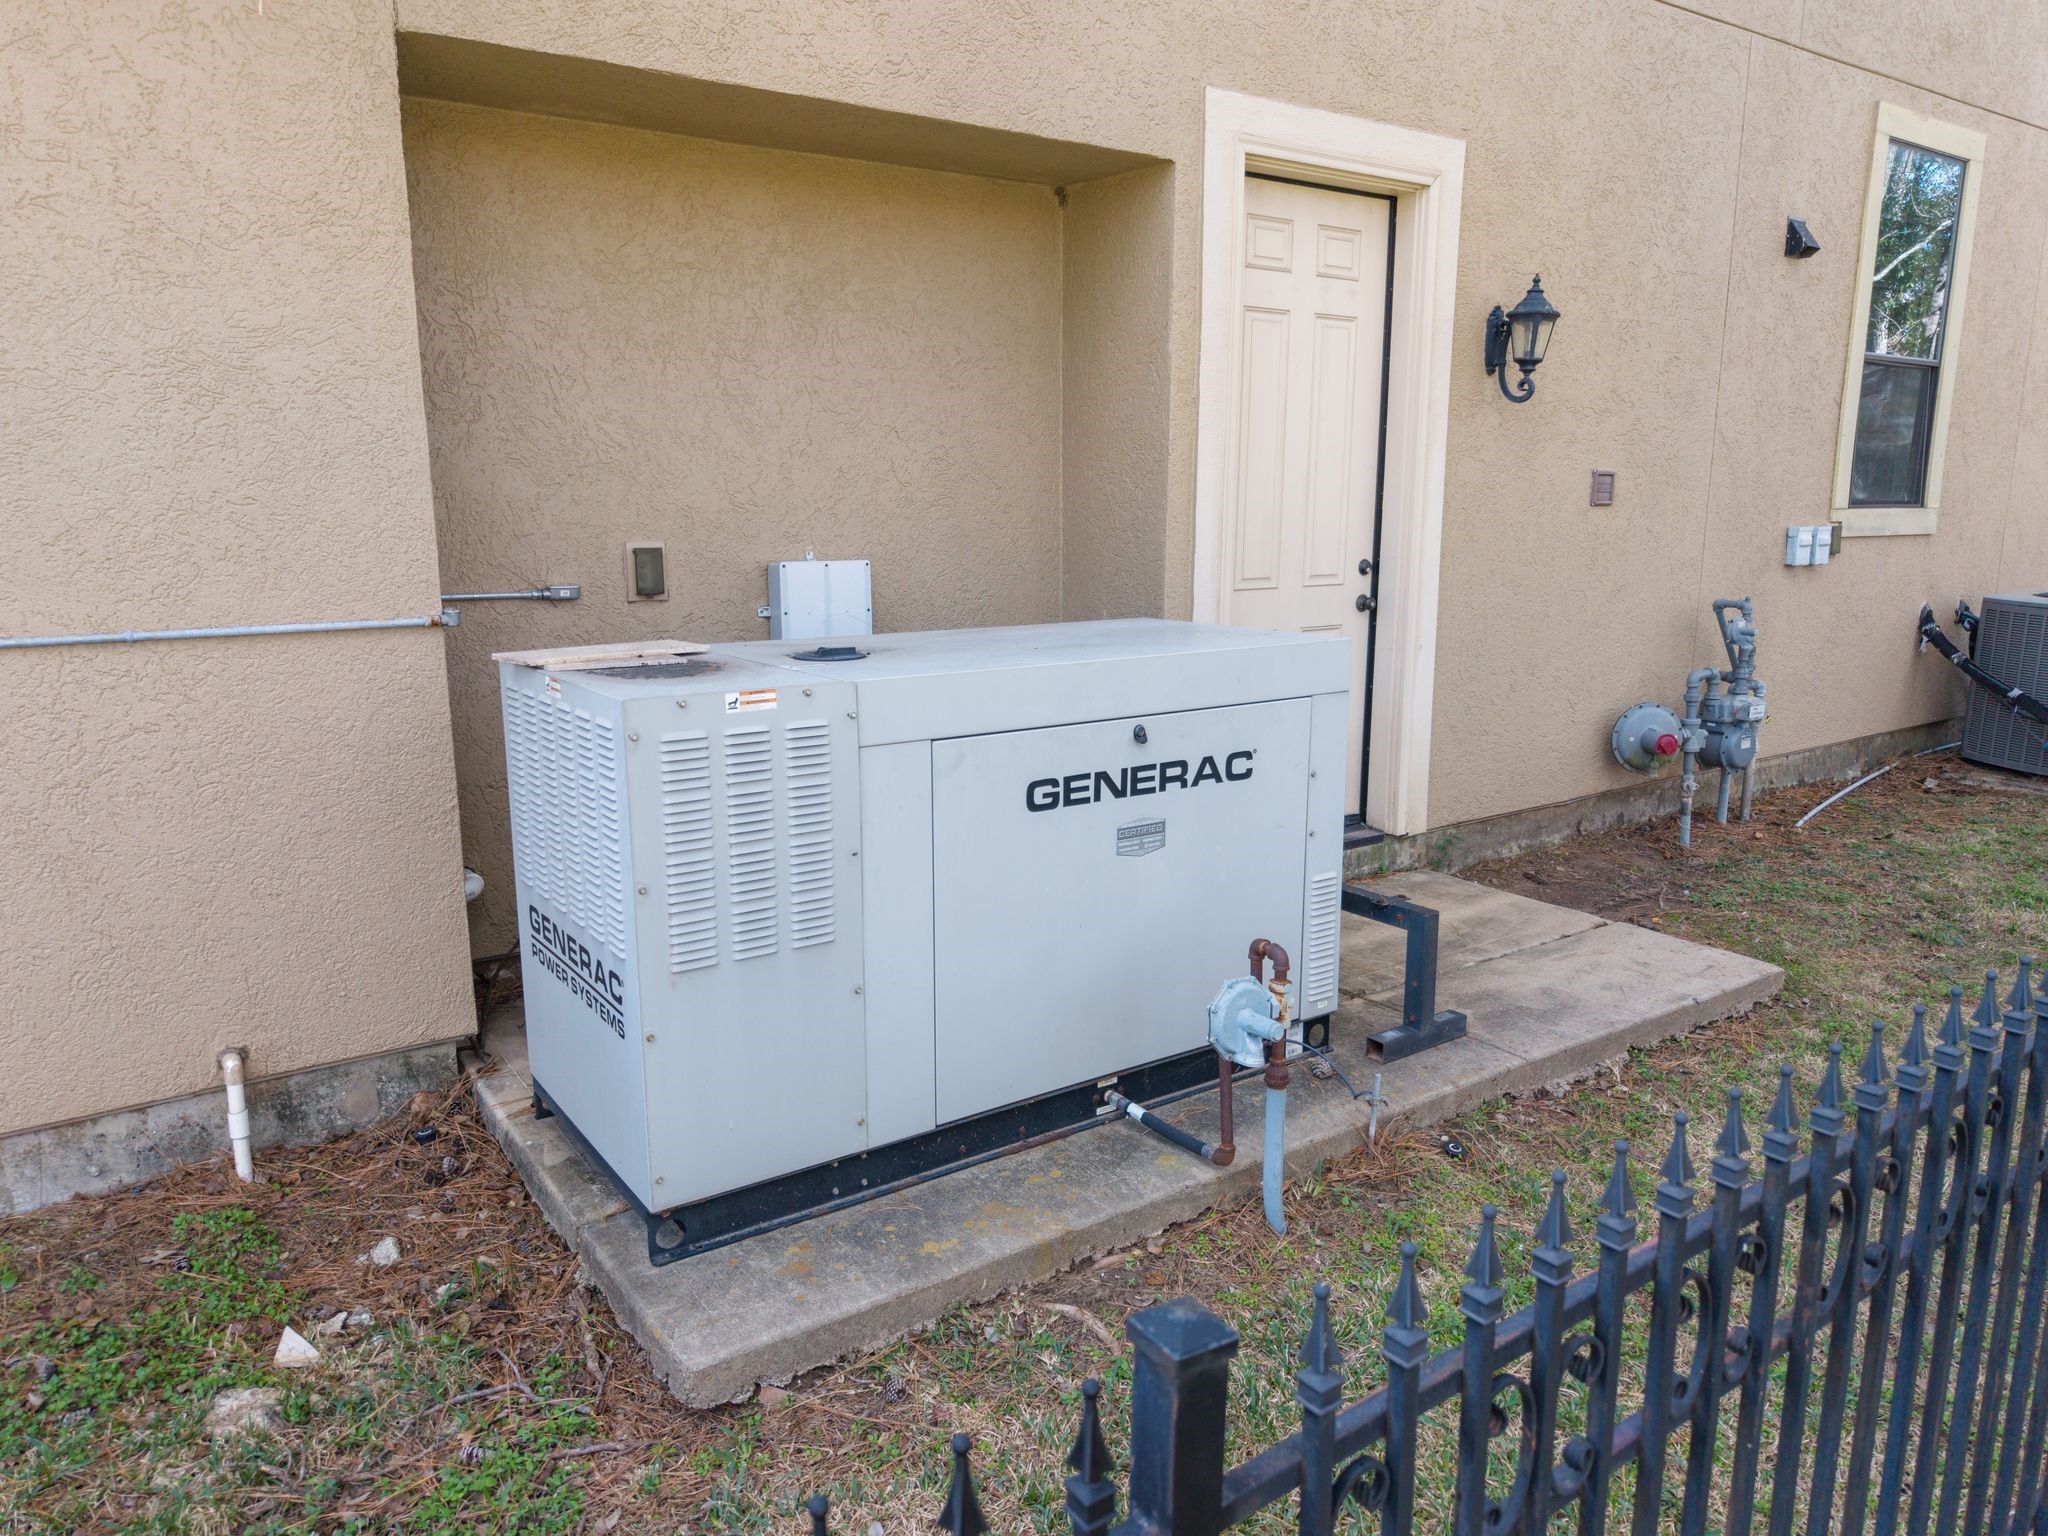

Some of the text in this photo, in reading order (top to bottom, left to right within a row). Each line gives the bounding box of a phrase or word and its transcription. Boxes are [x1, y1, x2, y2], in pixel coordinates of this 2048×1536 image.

[1026, 750, 1254, 812] GENERAC
[1118, 824, 1163, 838] CERTIFIED
[529, 904, 623, 1006] GENERAC
[532, 942, 625, 1040] POWER SYSTEMS
